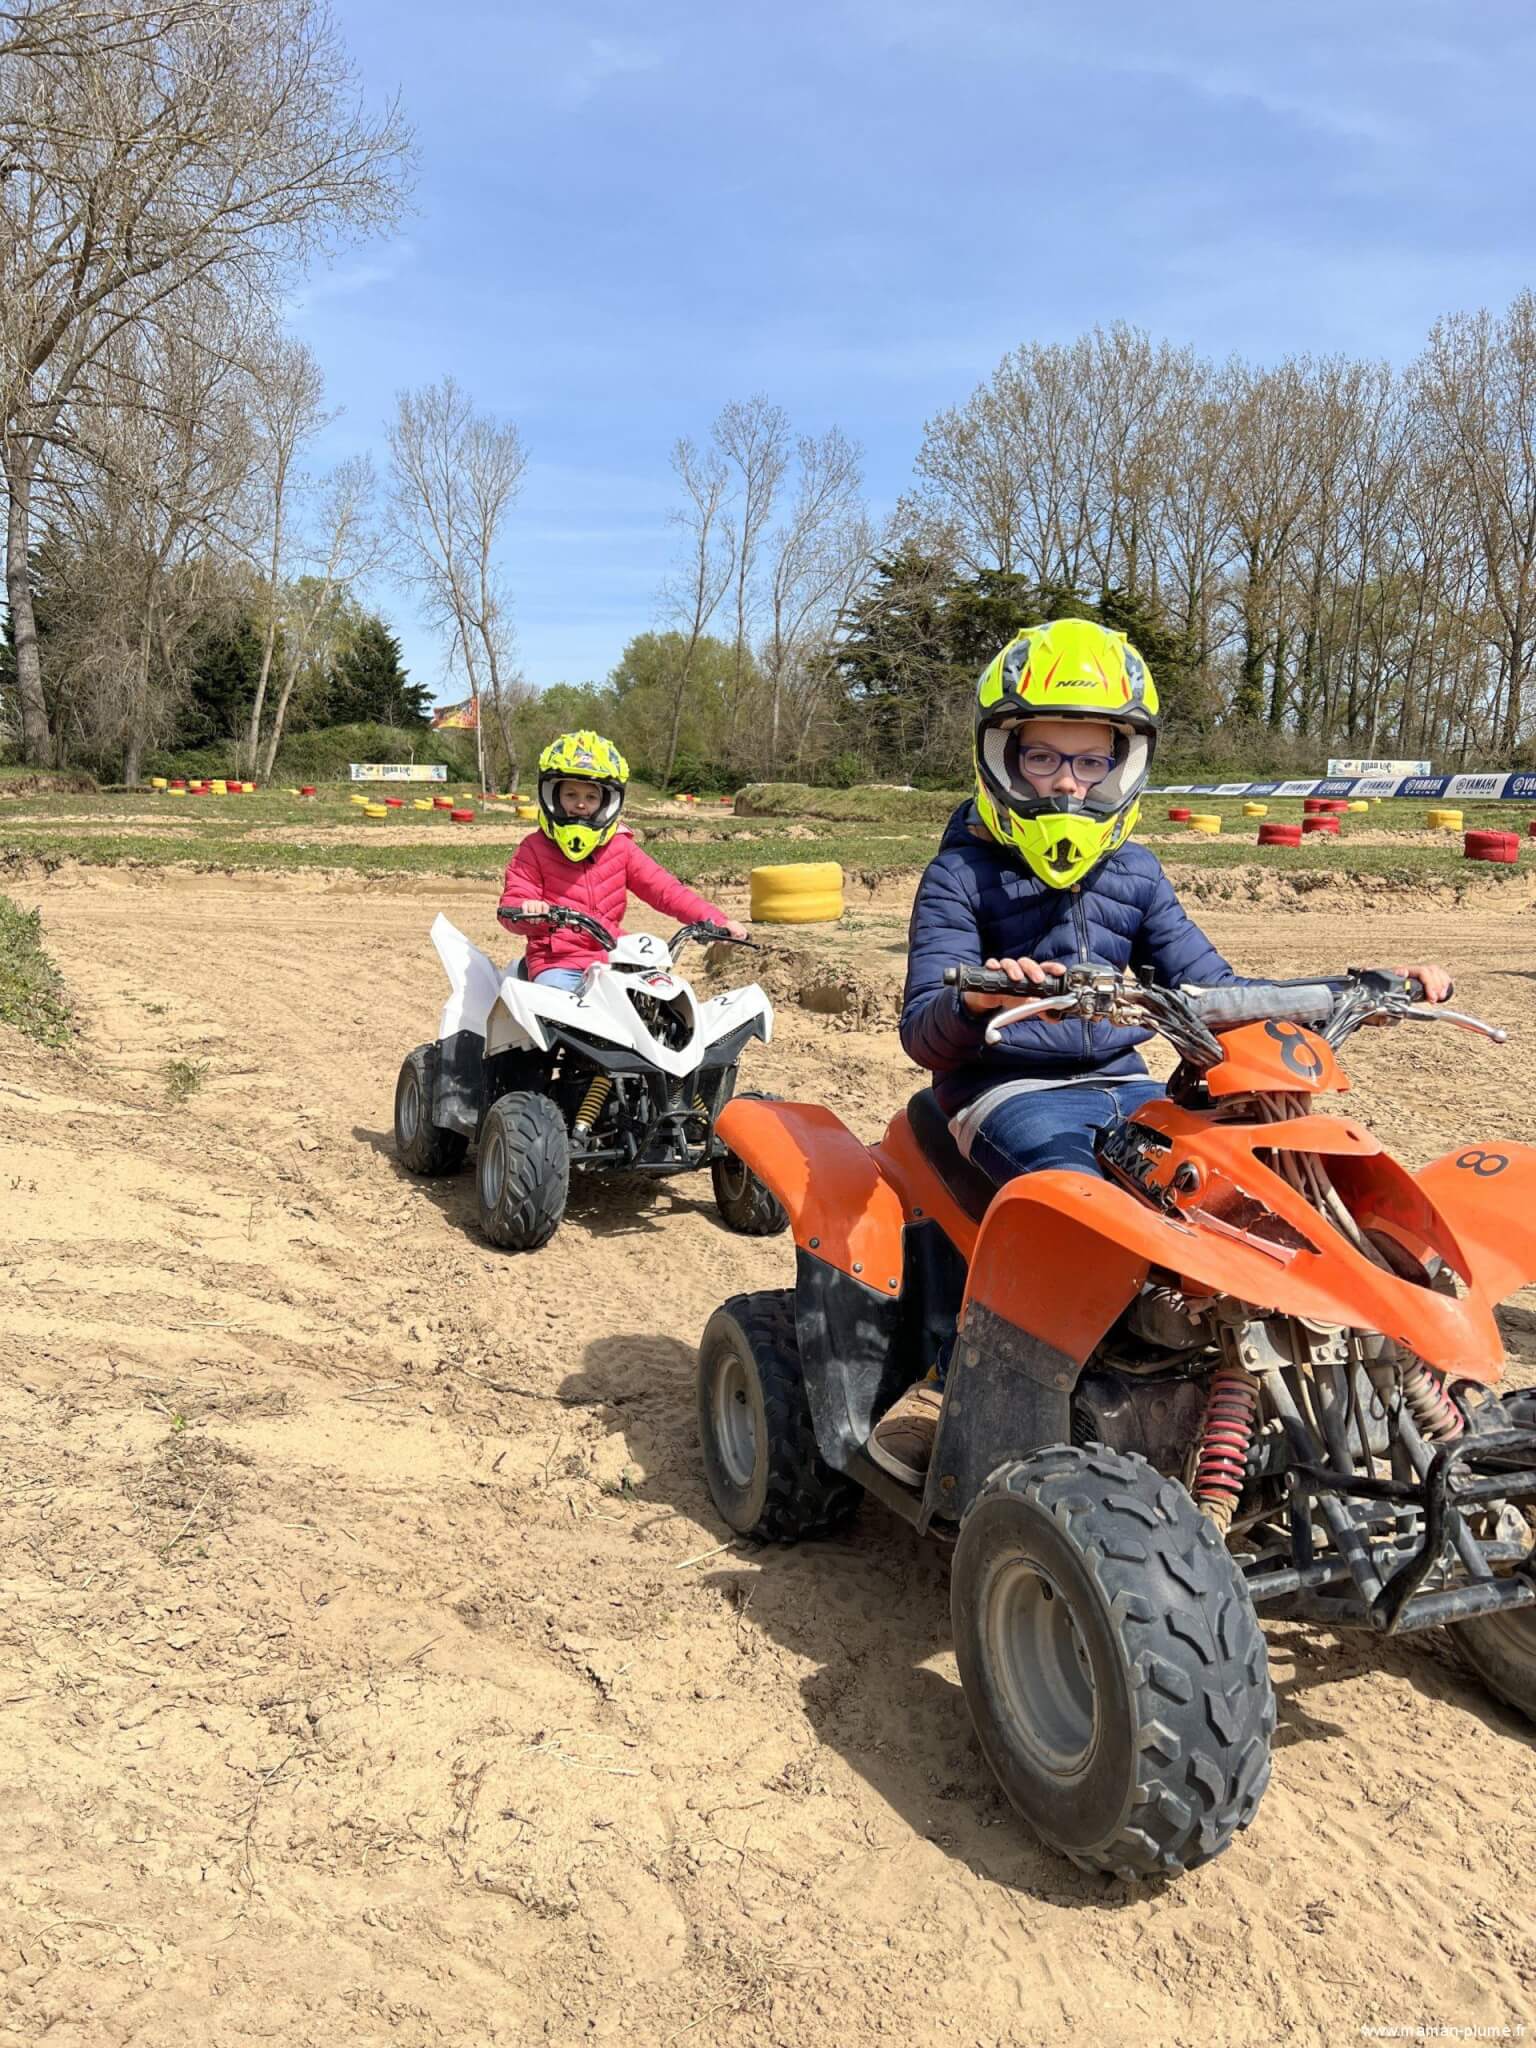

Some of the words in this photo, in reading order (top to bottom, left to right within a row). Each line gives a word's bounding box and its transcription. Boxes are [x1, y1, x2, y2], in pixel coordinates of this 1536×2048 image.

[1465, 778, 1498, 790] YAMAHA
[638, 936, 654, 954] 2
[568, 993, 591, 1008] 2
[713, 996, 733, 1006] 2
[1264, 1019, 1323, 1080] 8
[1456, 1150, 1509, 1177] 8
